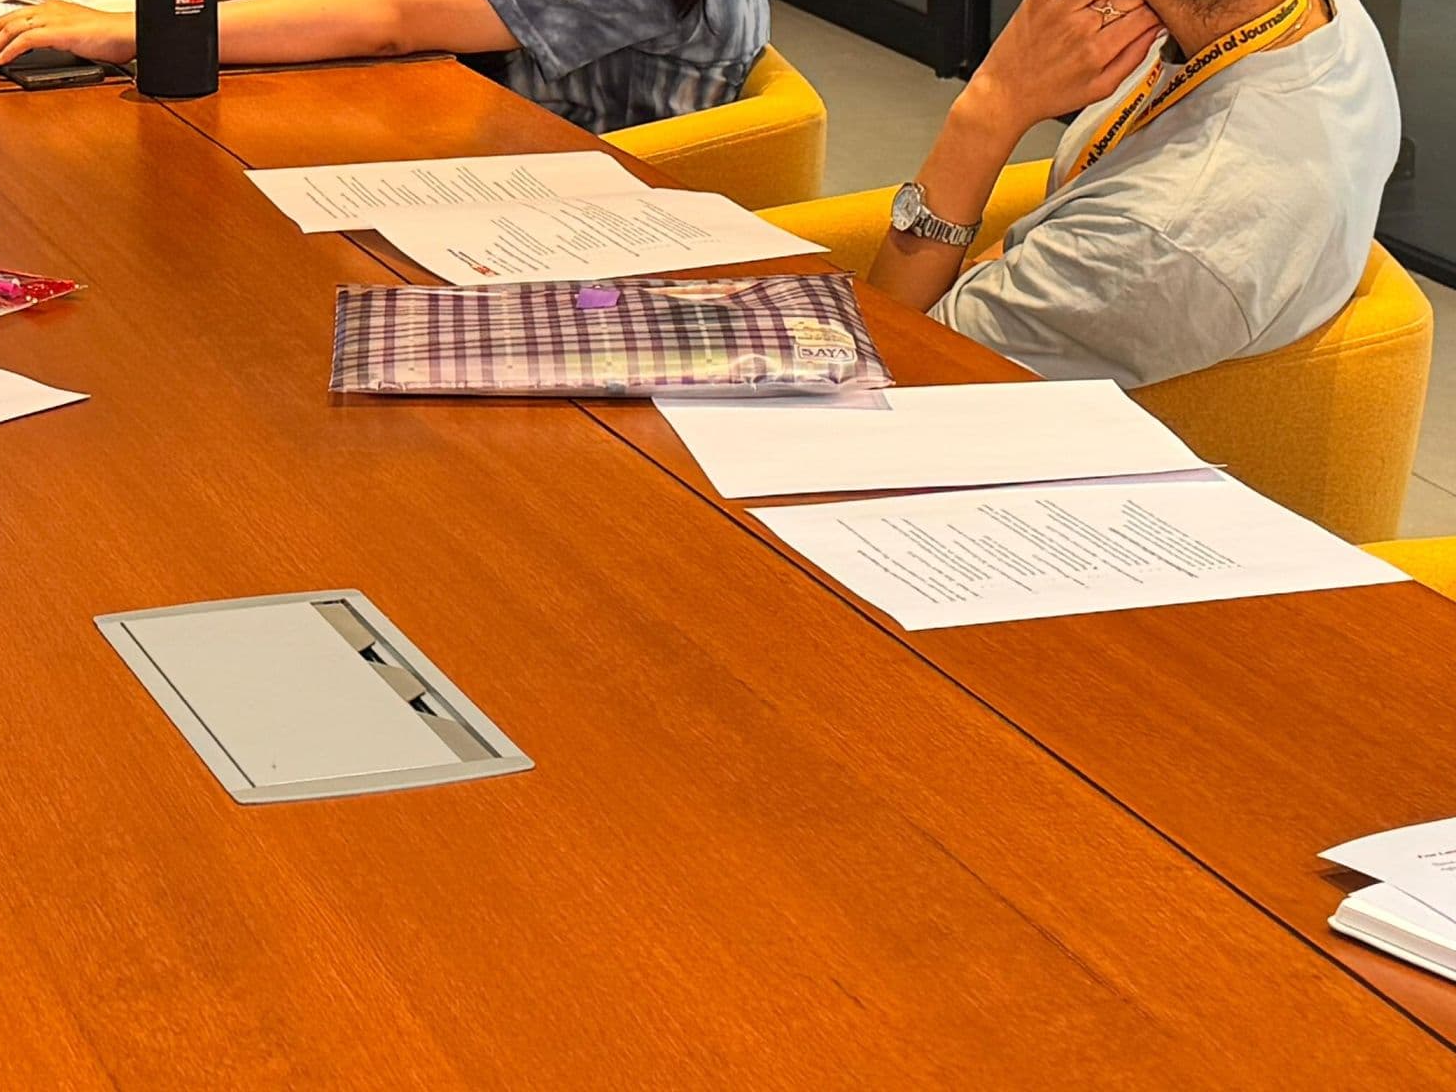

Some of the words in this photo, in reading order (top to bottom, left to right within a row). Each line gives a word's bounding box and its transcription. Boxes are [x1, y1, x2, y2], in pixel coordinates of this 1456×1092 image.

[1184, 44, 1224, 79] School
[1222, 35, 1238, 52] of
[1092, 92, 1145, 157] Journalism
